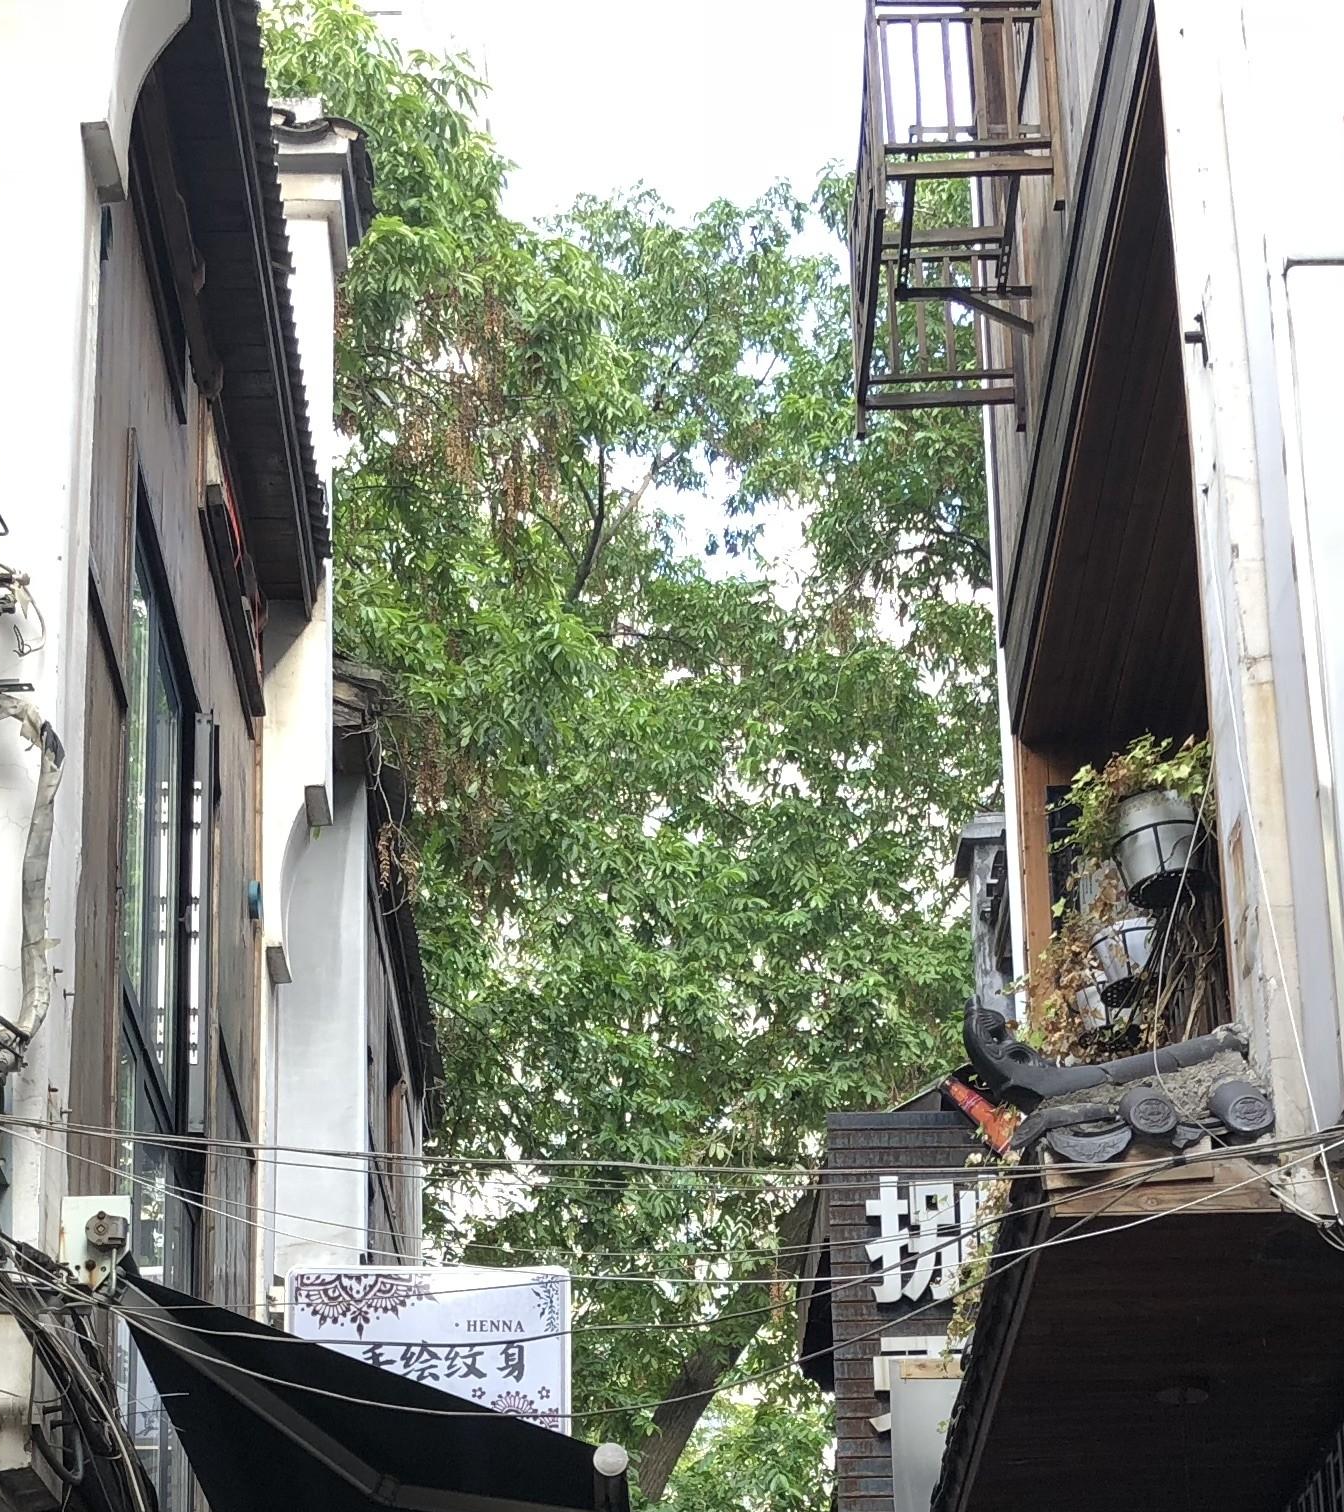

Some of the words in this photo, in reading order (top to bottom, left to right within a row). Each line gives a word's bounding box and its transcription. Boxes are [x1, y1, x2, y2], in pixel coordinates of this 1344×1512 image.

[466, 1319, 525, 1334] HENNA
[361, 1340, 526, 1383] 手绘纹身
